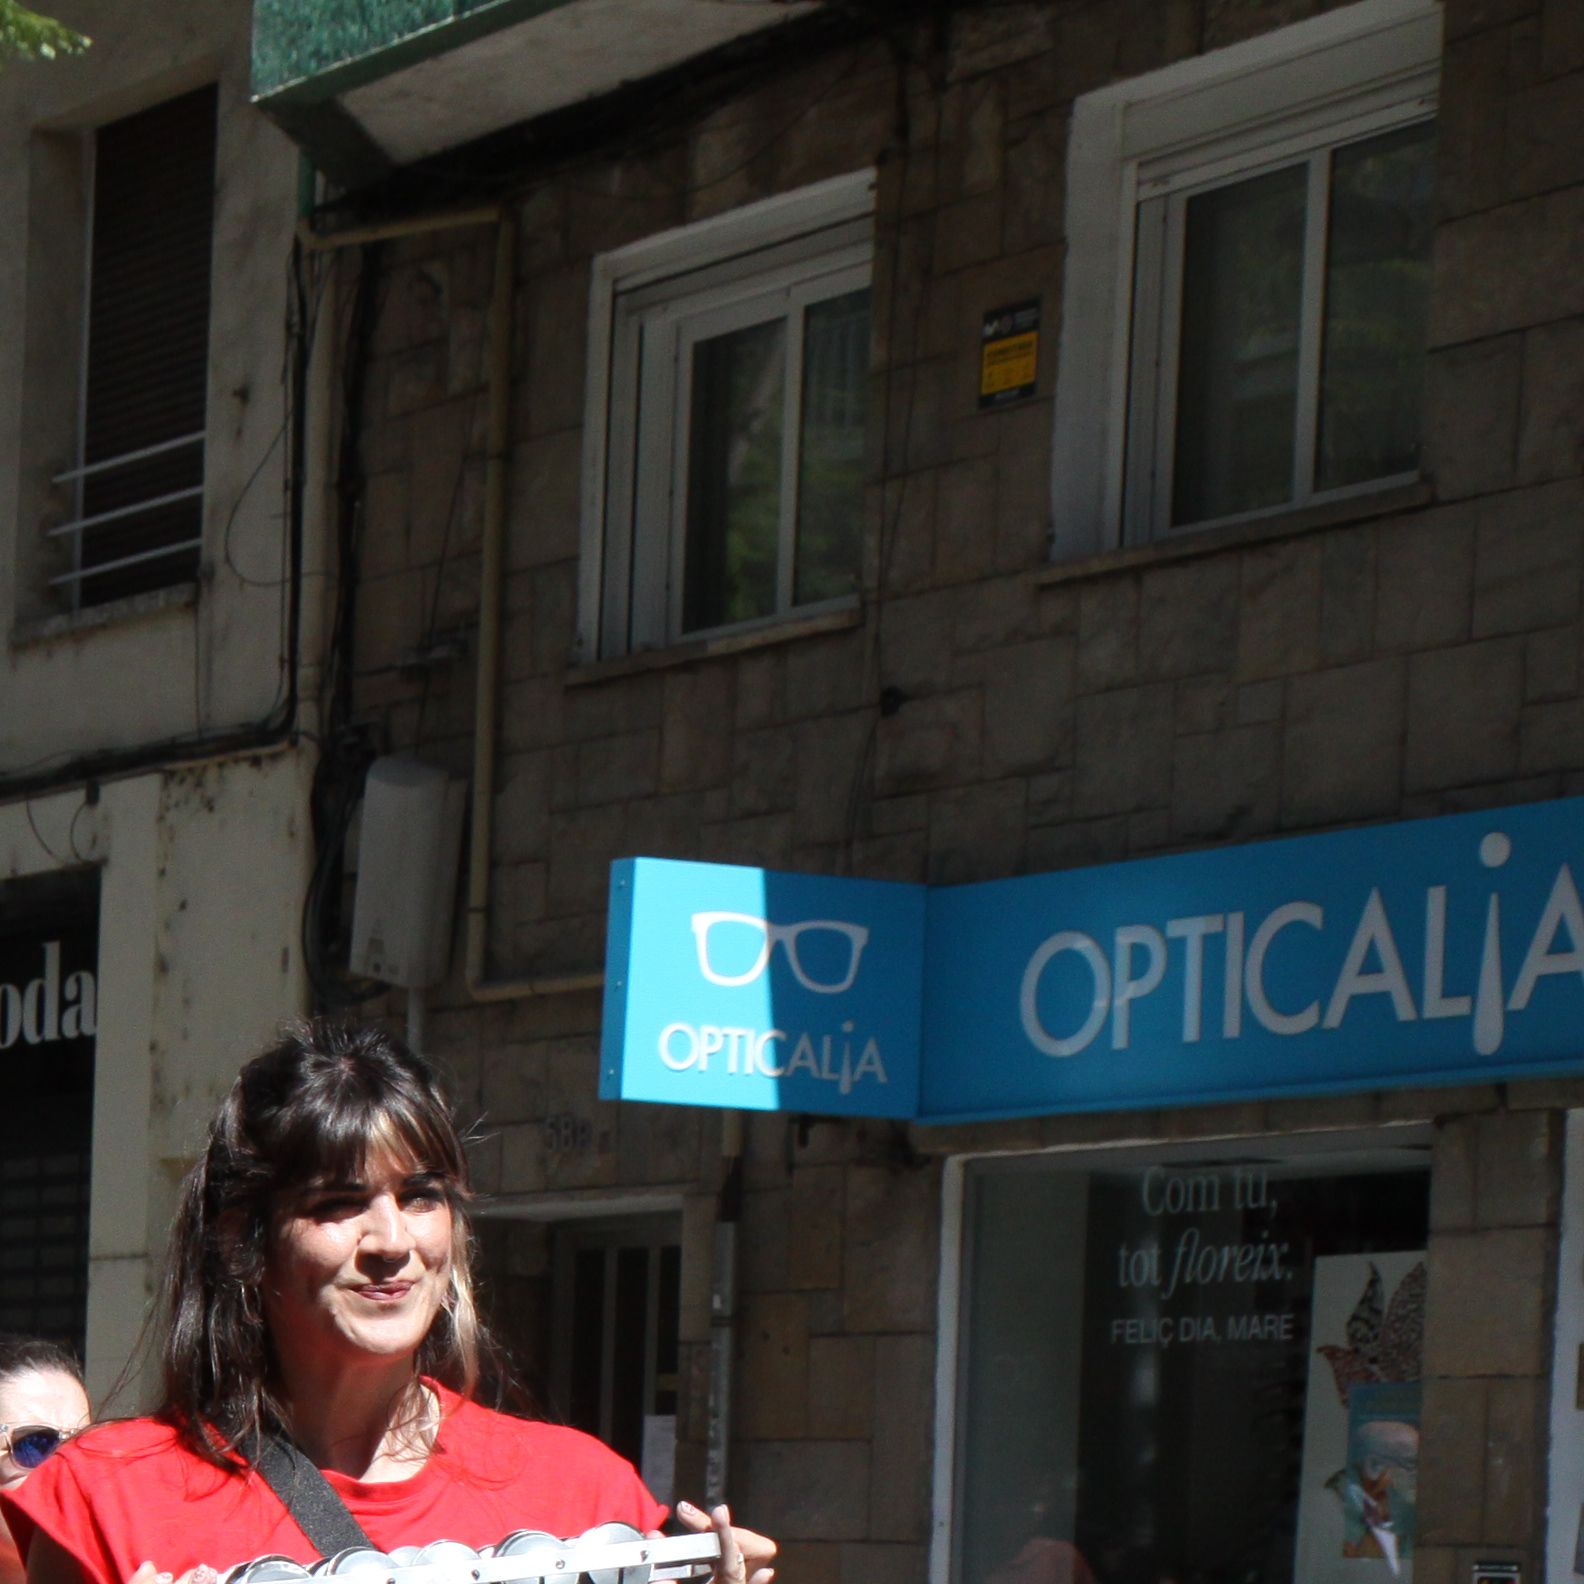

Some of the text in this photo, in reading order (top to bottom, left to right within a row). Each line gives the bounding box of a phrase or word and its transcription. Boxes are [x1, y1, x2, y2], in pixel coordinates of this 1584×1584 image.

[1142, 1165, 1221, 1217] Com
[1118, 1227, 1294, 1300] tot floreix.
[1228, 1313, 1295, 1341] MARE
